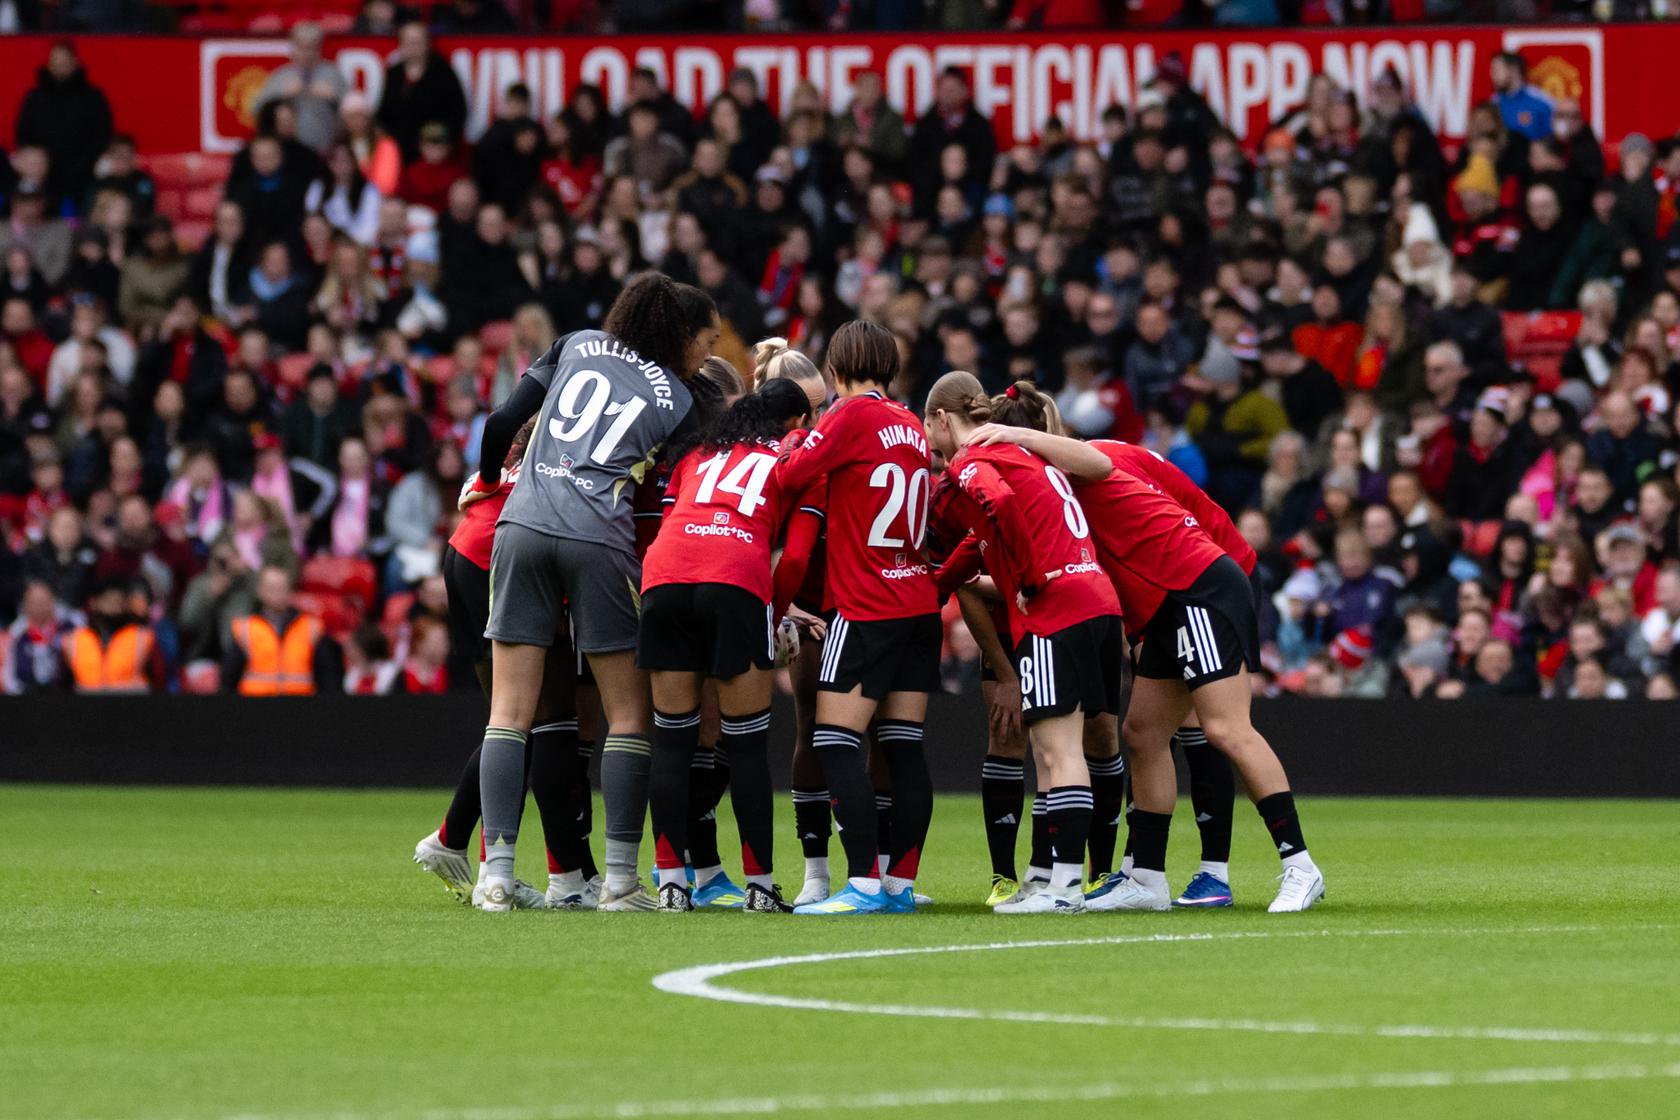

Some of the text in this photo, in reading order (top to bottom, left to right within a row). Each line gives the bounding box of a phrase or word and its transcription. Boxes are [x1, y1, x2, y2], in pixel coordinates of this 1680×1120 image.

[1190, 42, 1313, 141] APP
[574, 340, 674, 411] TULLIS-JOYCE
[549, 369, 648, 466] 91
[877, 424, 928, 458] HINATA
[694, 450, 779, 517] 14
[867, 462, 930, 551] 20
[1044, 465, 1089, 539] 8
[1019, 656, 1034, 695] 8
[1176, 625, 1196, 662] 4
